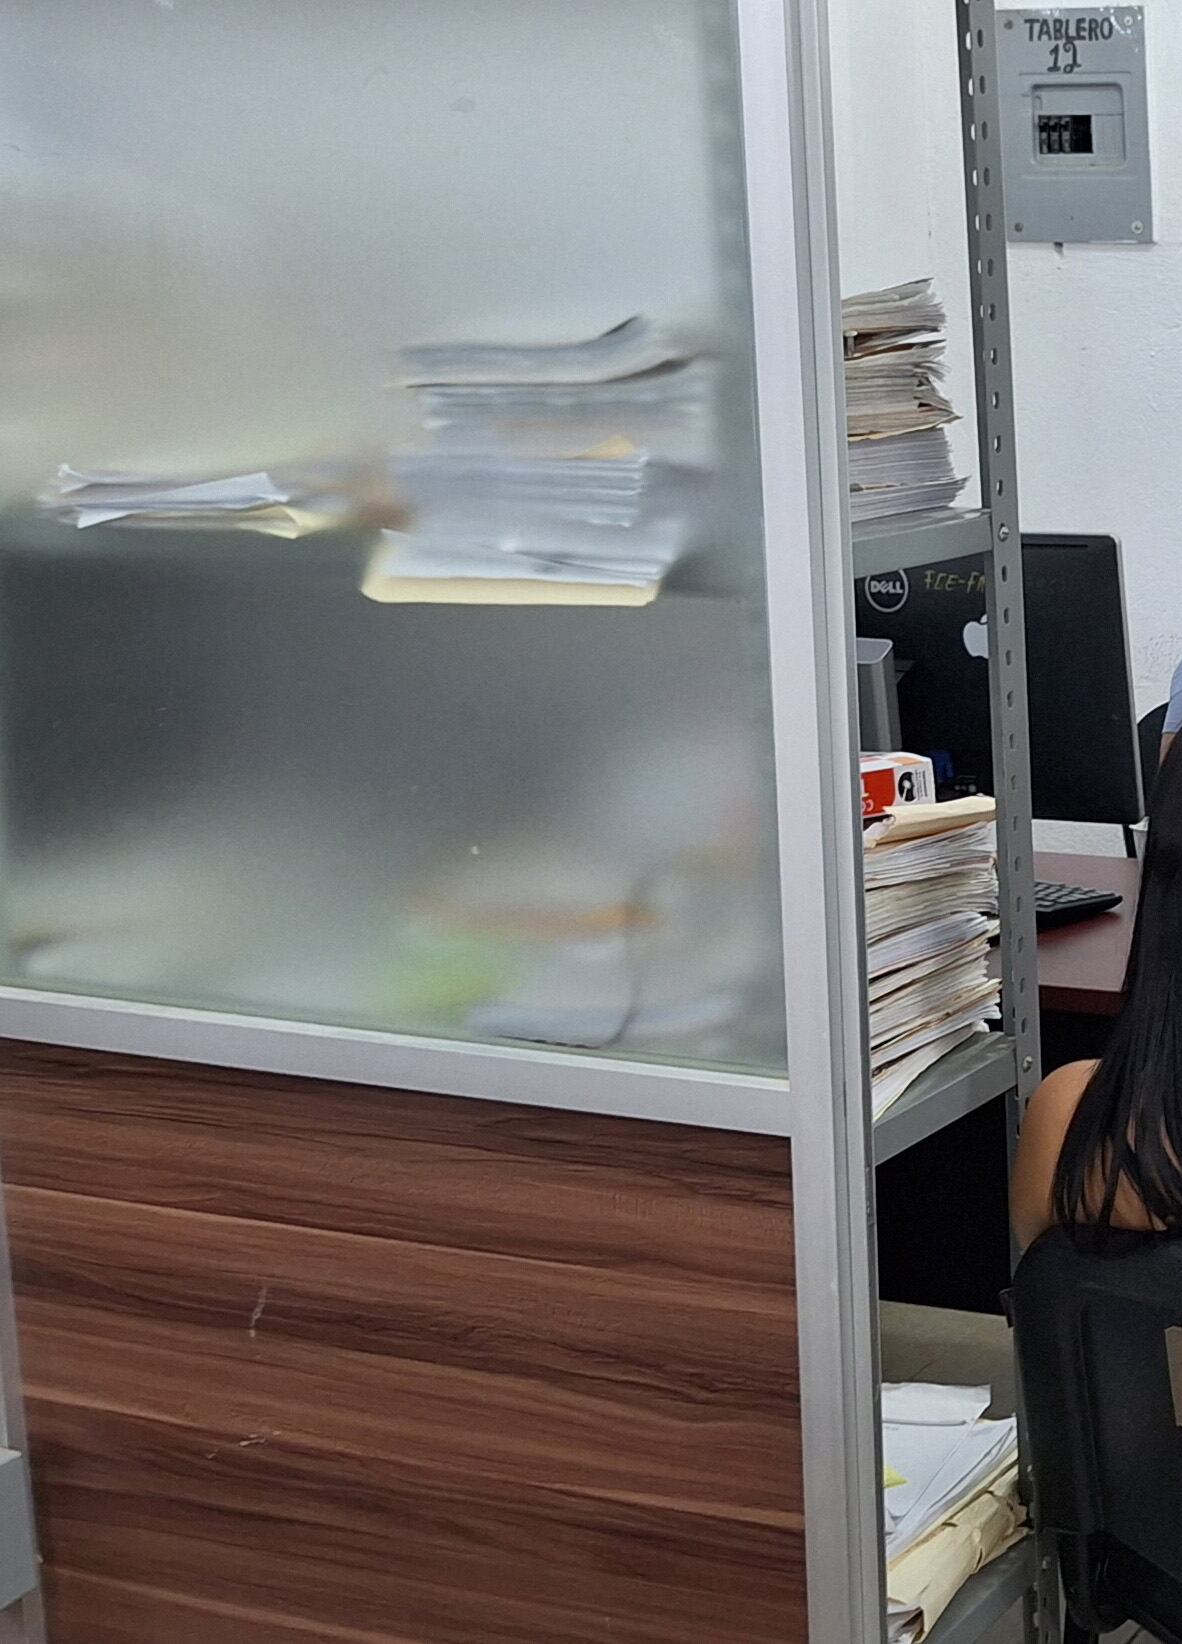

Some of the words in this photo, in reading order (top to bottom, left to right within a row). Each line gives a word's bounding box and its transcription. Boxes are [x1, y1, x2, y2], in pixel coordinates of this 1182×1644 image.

[1023, 17, 1114, 42] TABLERO
[1046, 41, 1082, 74] 12
[869, 580, 904, 594] DELL
